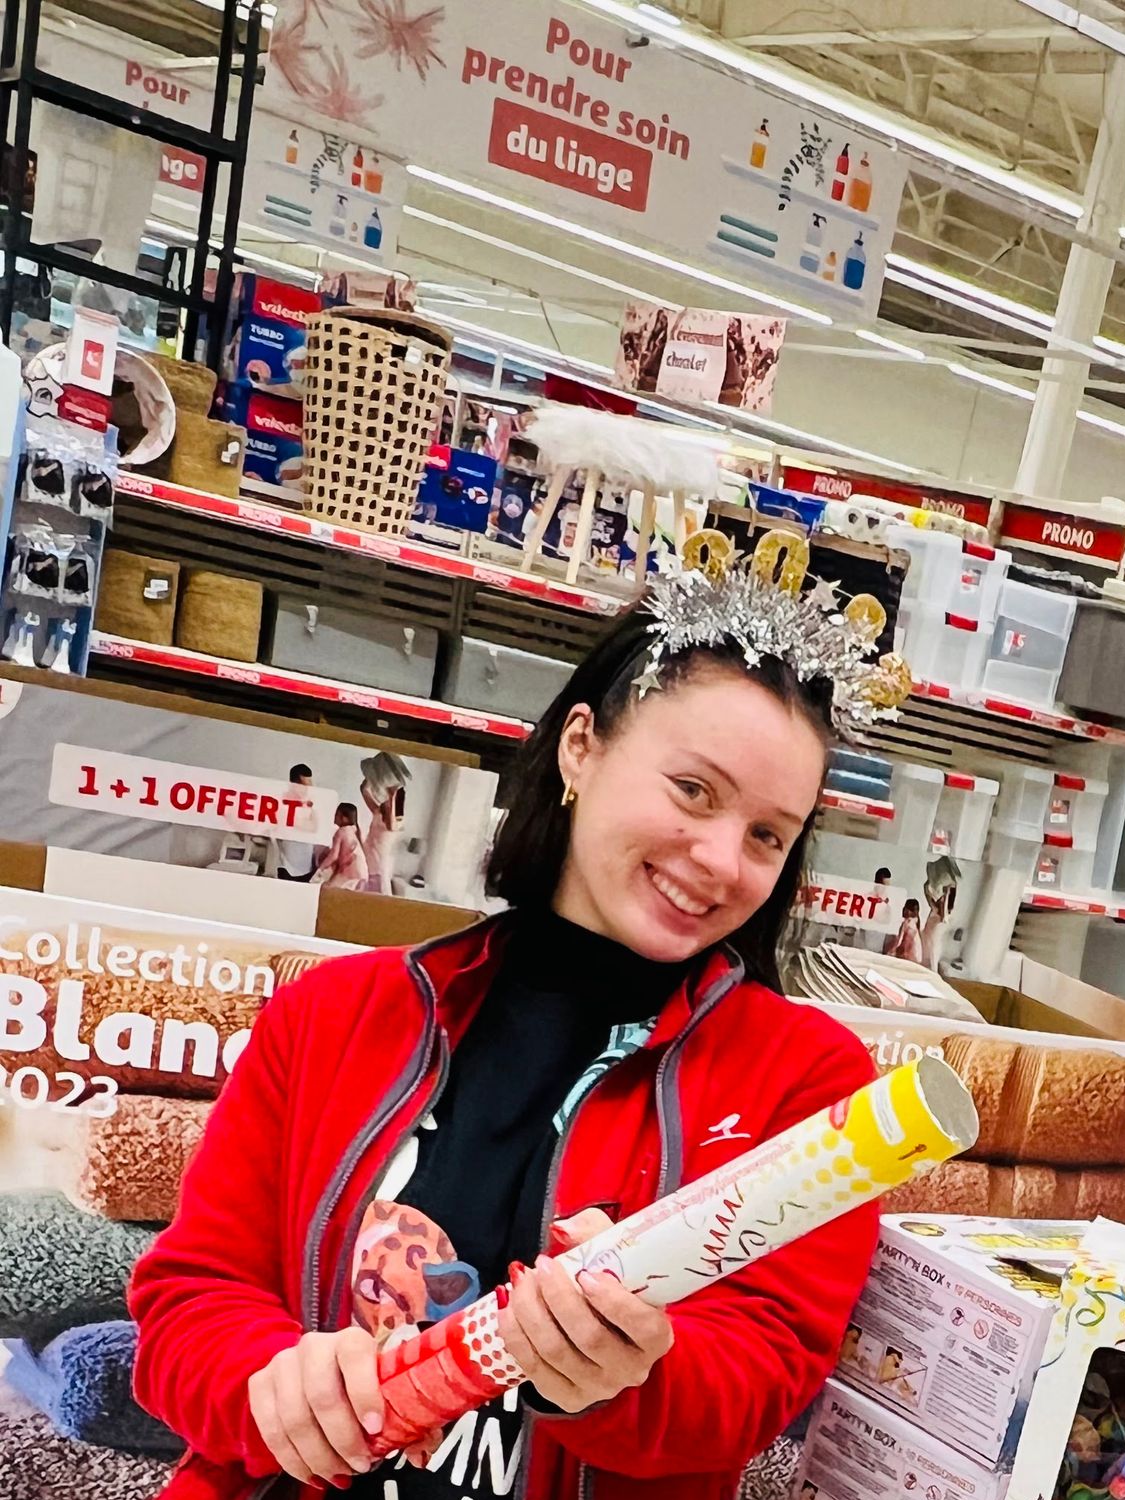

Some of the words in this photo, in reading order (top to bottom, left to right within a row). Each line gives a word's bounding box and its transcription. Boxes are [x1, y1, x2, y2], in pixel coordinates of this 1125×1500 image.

[546, 17, 632, 83] Pour
[125, 59, 191, 105] Pour
[461, 46, 610, 128] prendre
[616, 112, 691, 160] soin
[506, 124, 548, 163] du
[553, 135, 633, 193] linge
[1042, 521, 1096, 550] PROMO
[169, 780, 303, 828] OFFERT
[0, 916, 275, 998] Collection
[0, 1062, 119, 1119] 023
[921, 1263, 946, 1287] BOX
